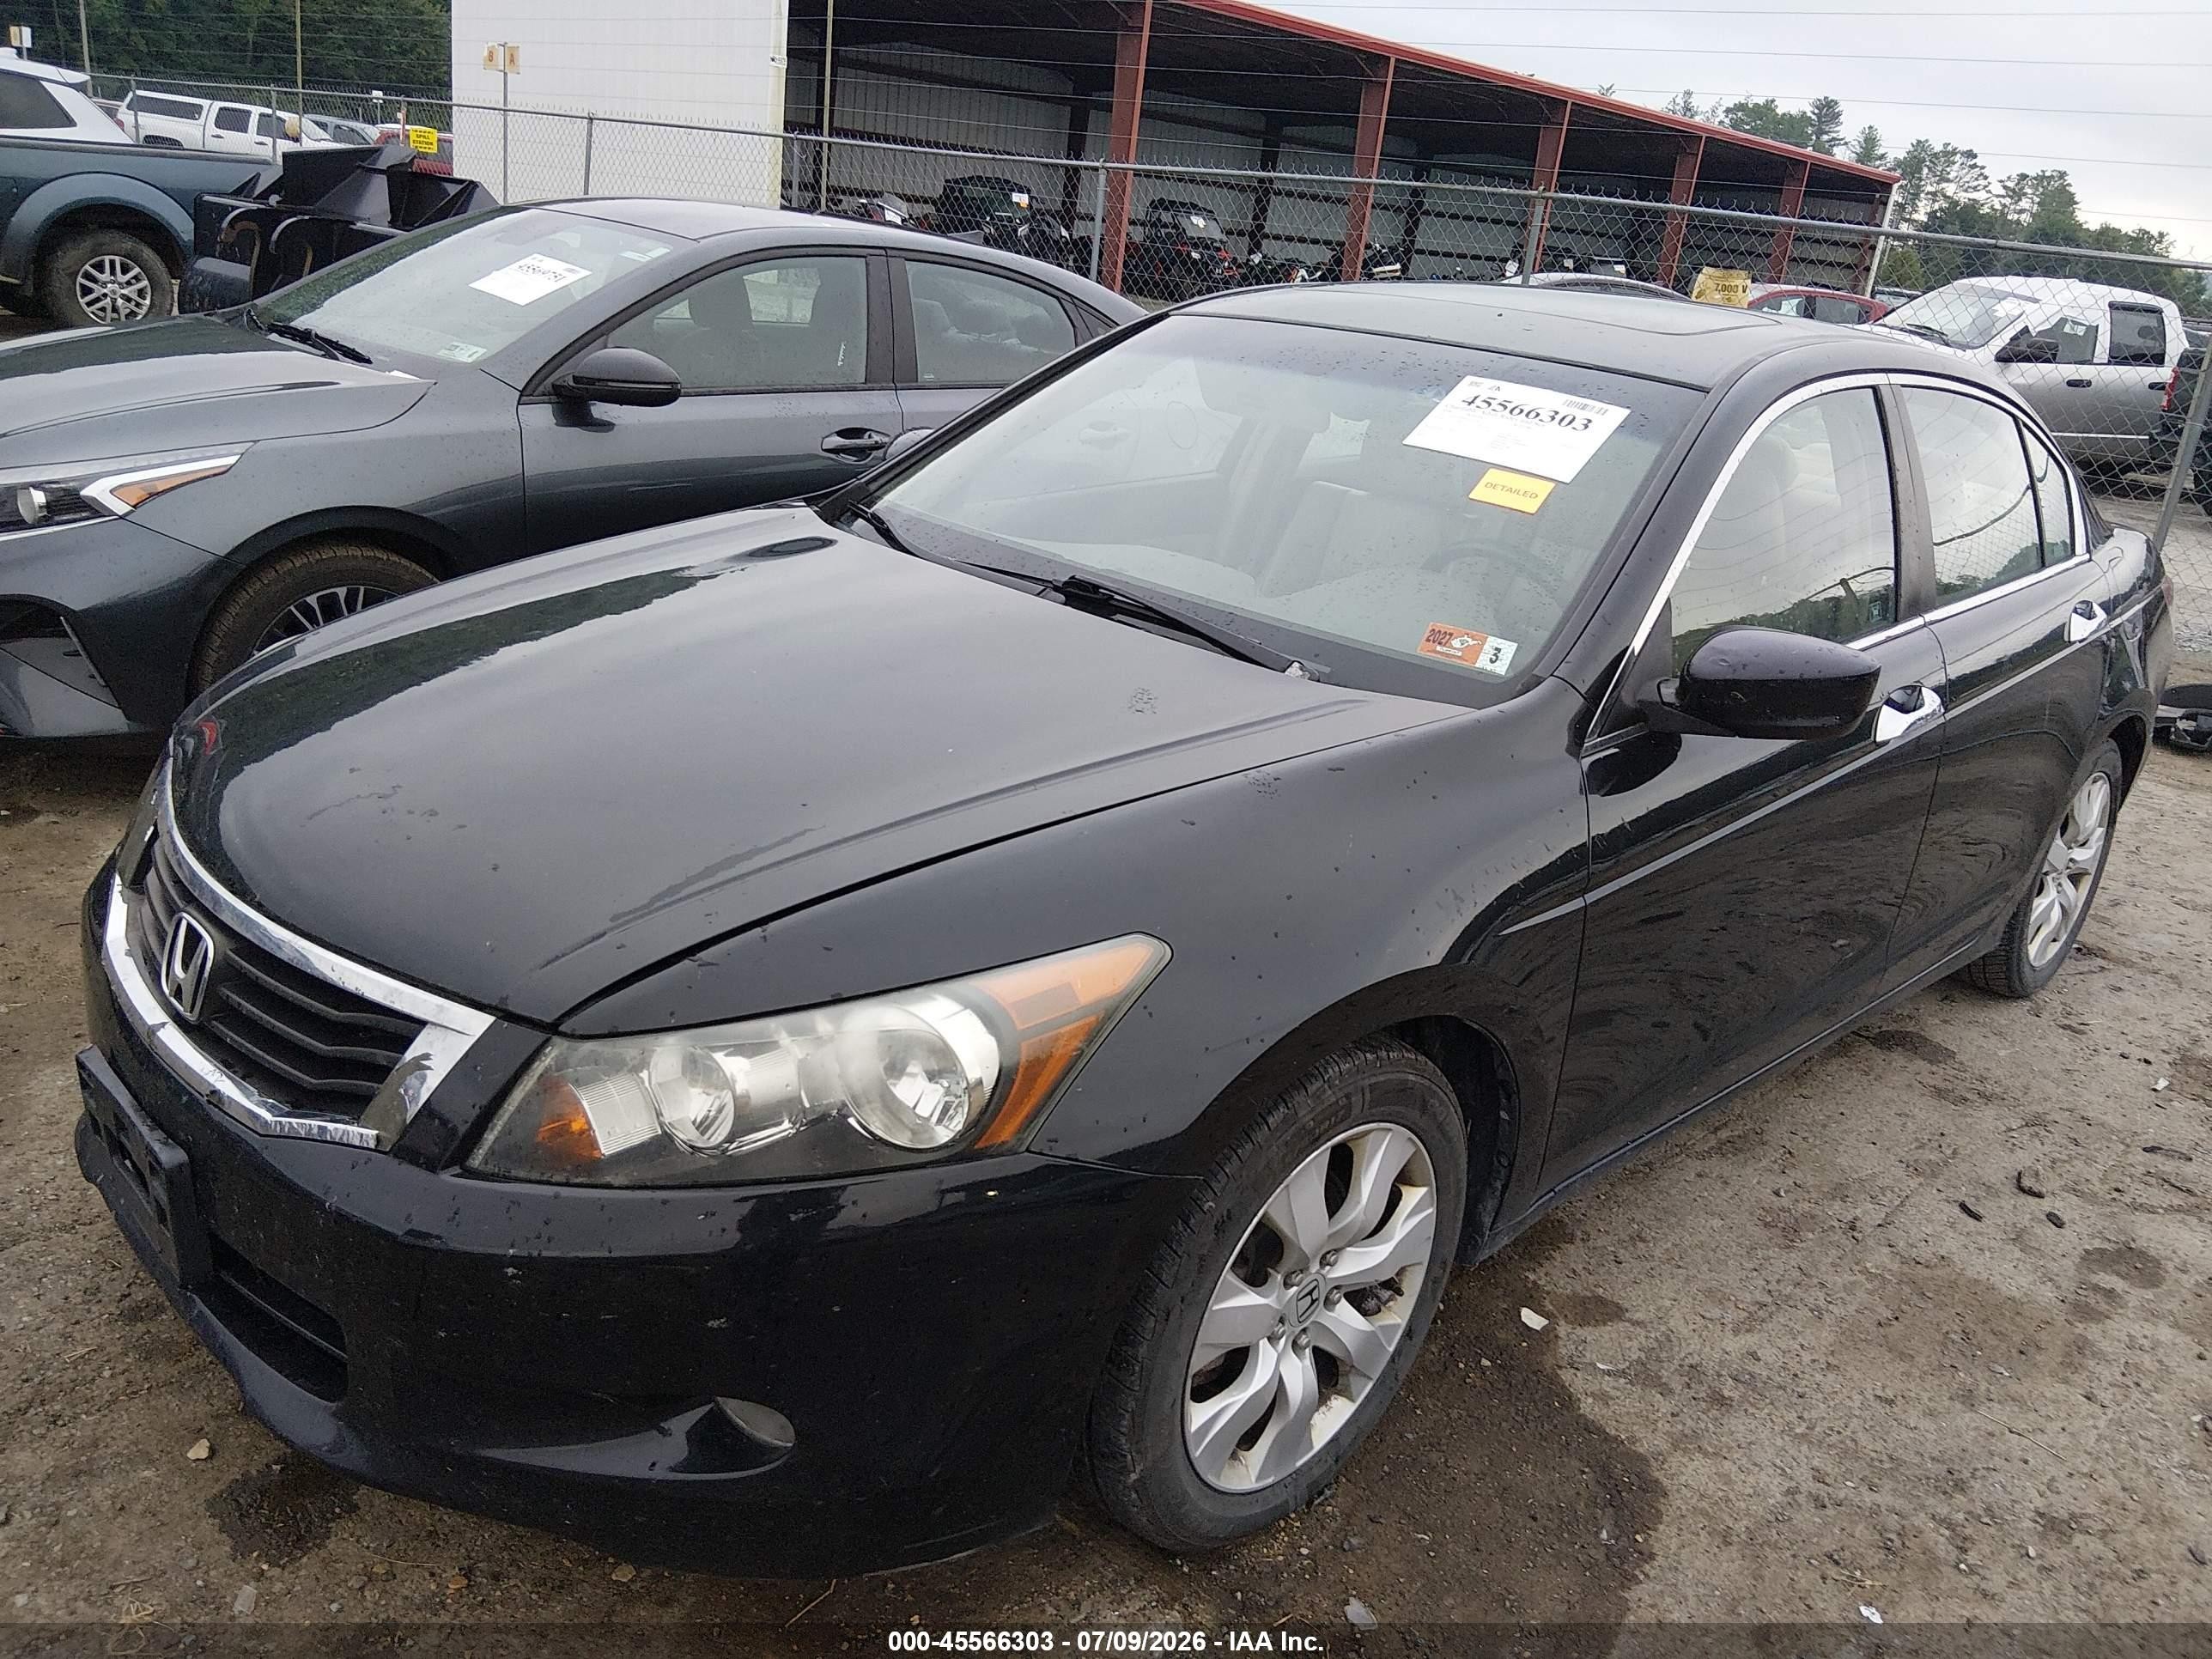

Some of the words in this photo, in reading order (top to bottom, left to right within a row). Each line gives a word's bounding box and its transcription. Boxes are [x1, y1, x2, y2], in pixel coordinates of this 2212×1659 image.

[509, 52, 516, 65] A
[1462, 394, 1593, 432] 45566303
[1484, 481, 1539, 500] DETAILED
[1425, 629, 1454, 647] 2027
[1489, 647, 1502, 665] 3
